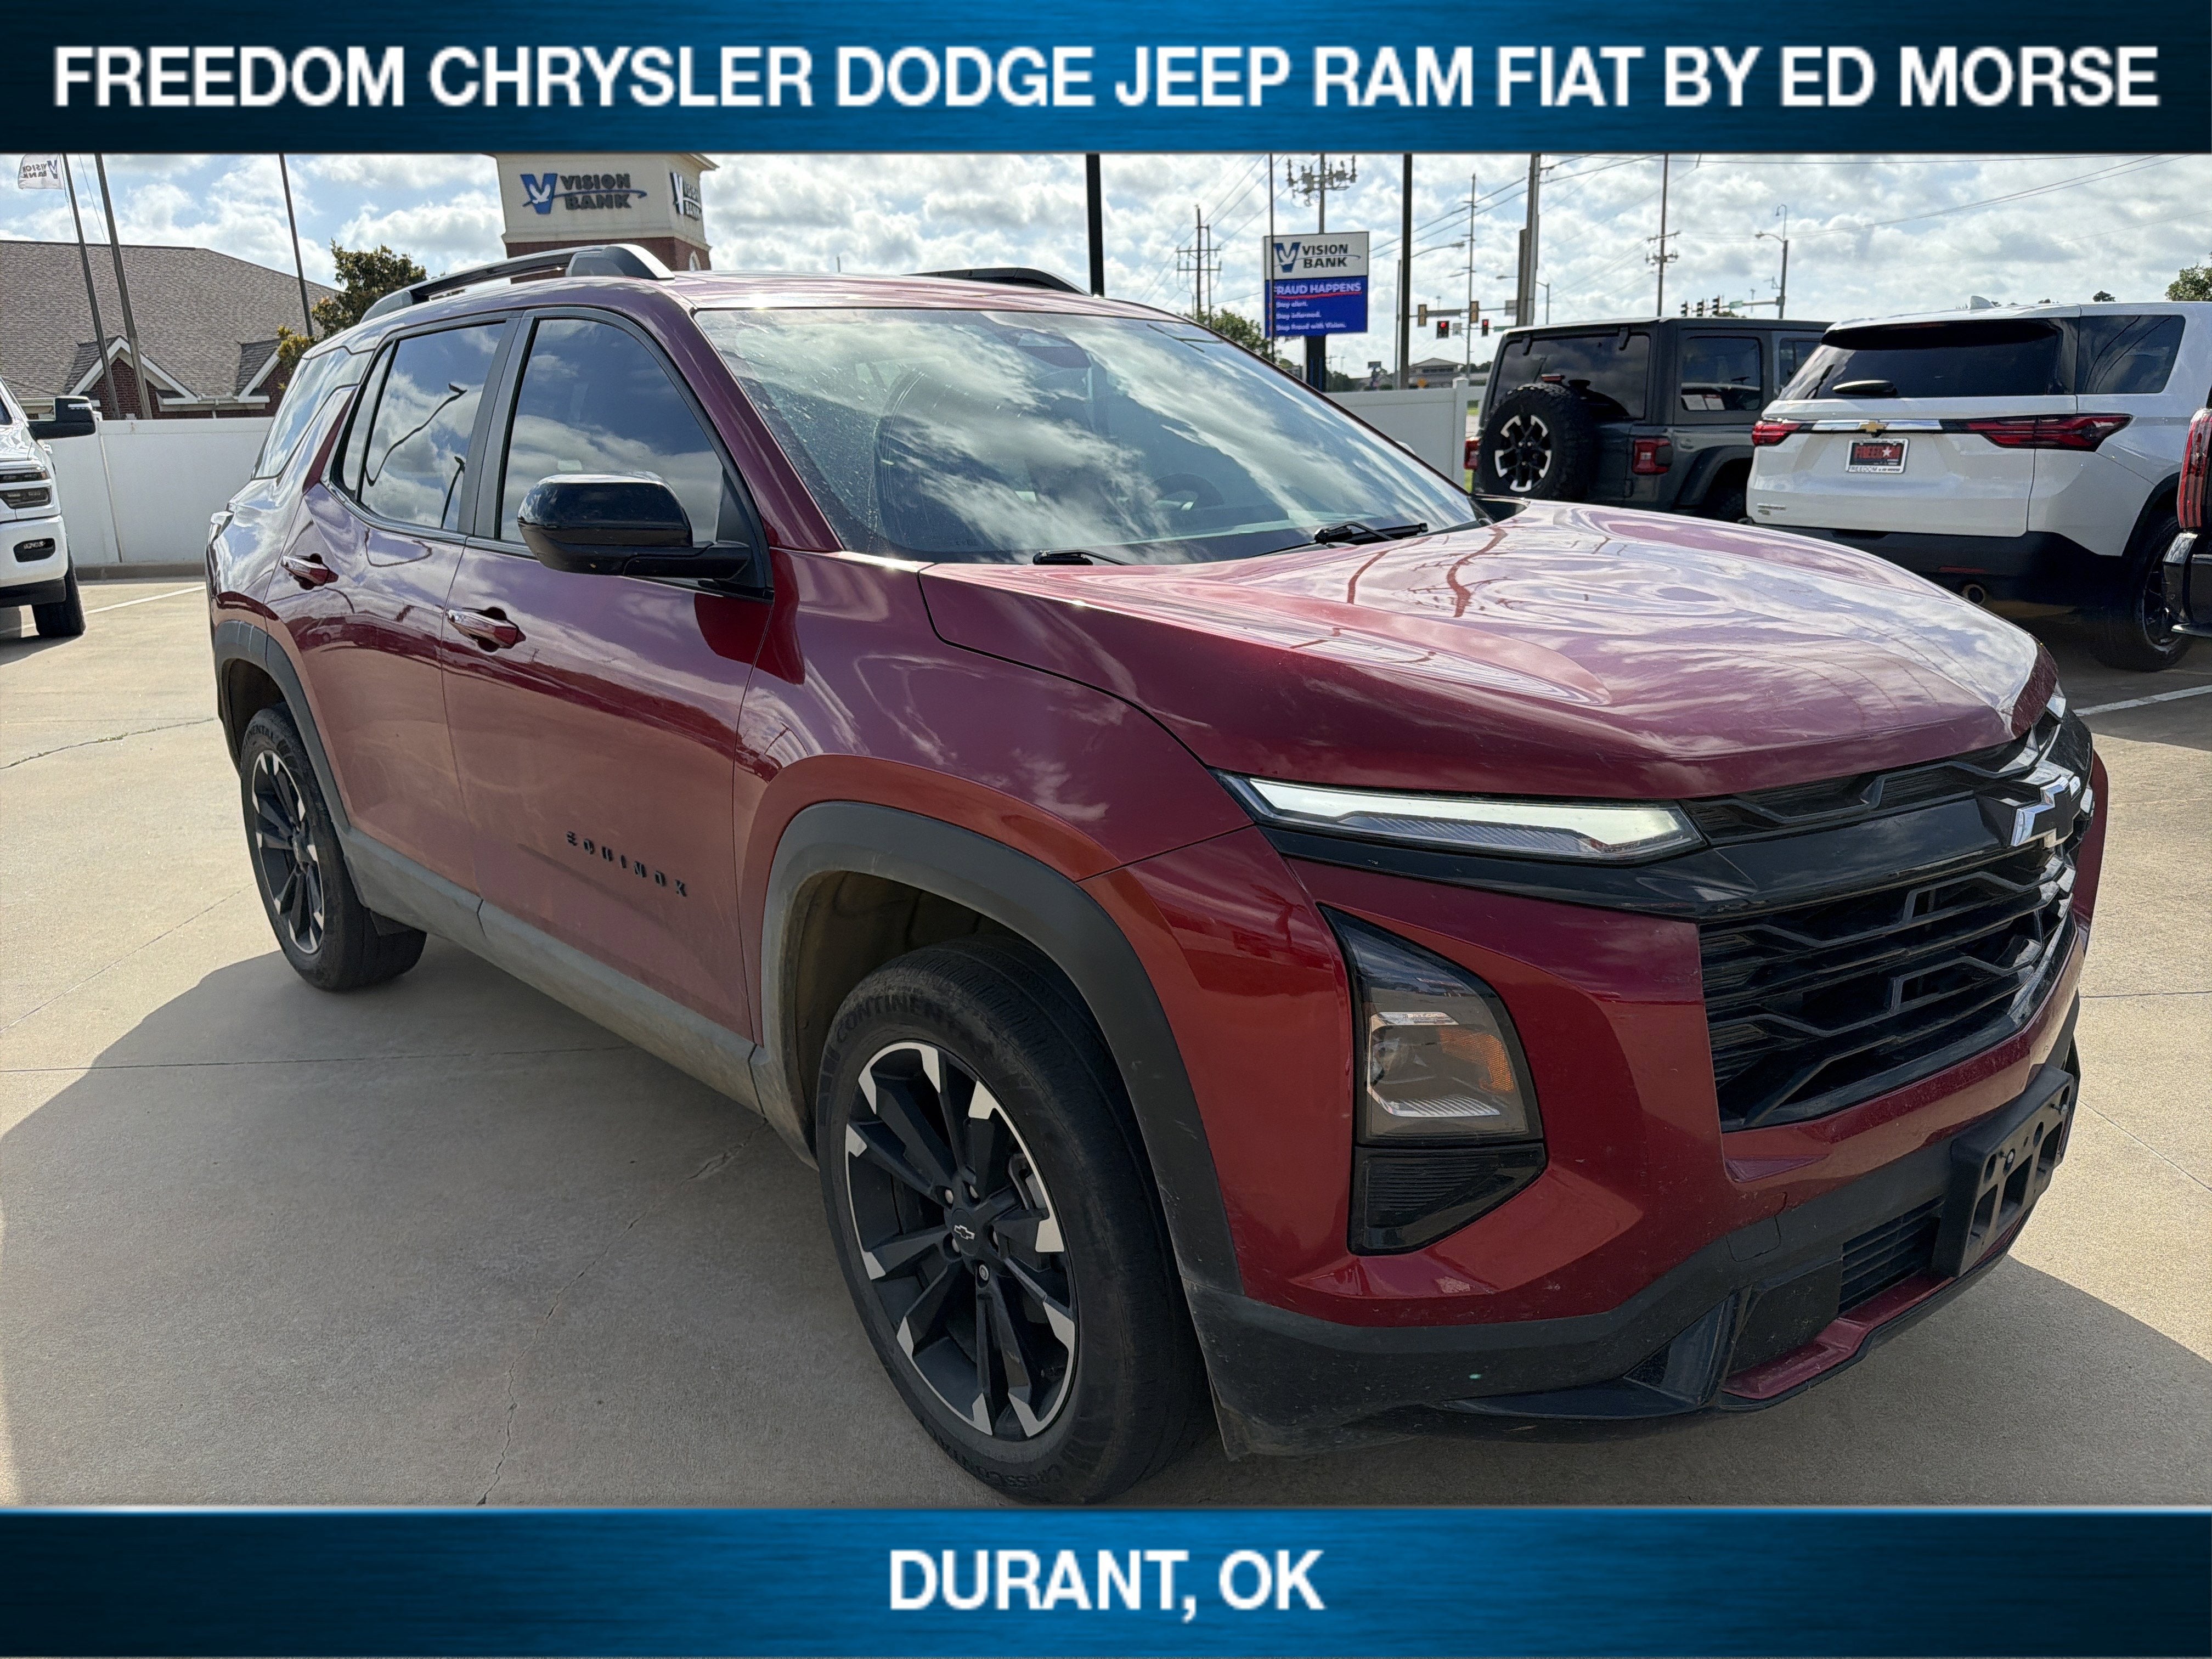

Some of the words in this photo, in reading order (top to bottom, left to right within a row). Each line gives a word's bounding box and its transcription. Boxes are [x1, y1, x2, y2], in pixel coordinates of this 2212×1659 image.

[560, 173, 631, 190] VISION
[565, 194, 632, 210] BANK
[1302, 244, 1348, 256] VISION
[1303, 257, 1348, 268] BANK
[1310, 283, 1362, 294] HAPPENS
[566, 831, 687, 897] EQUINOX
